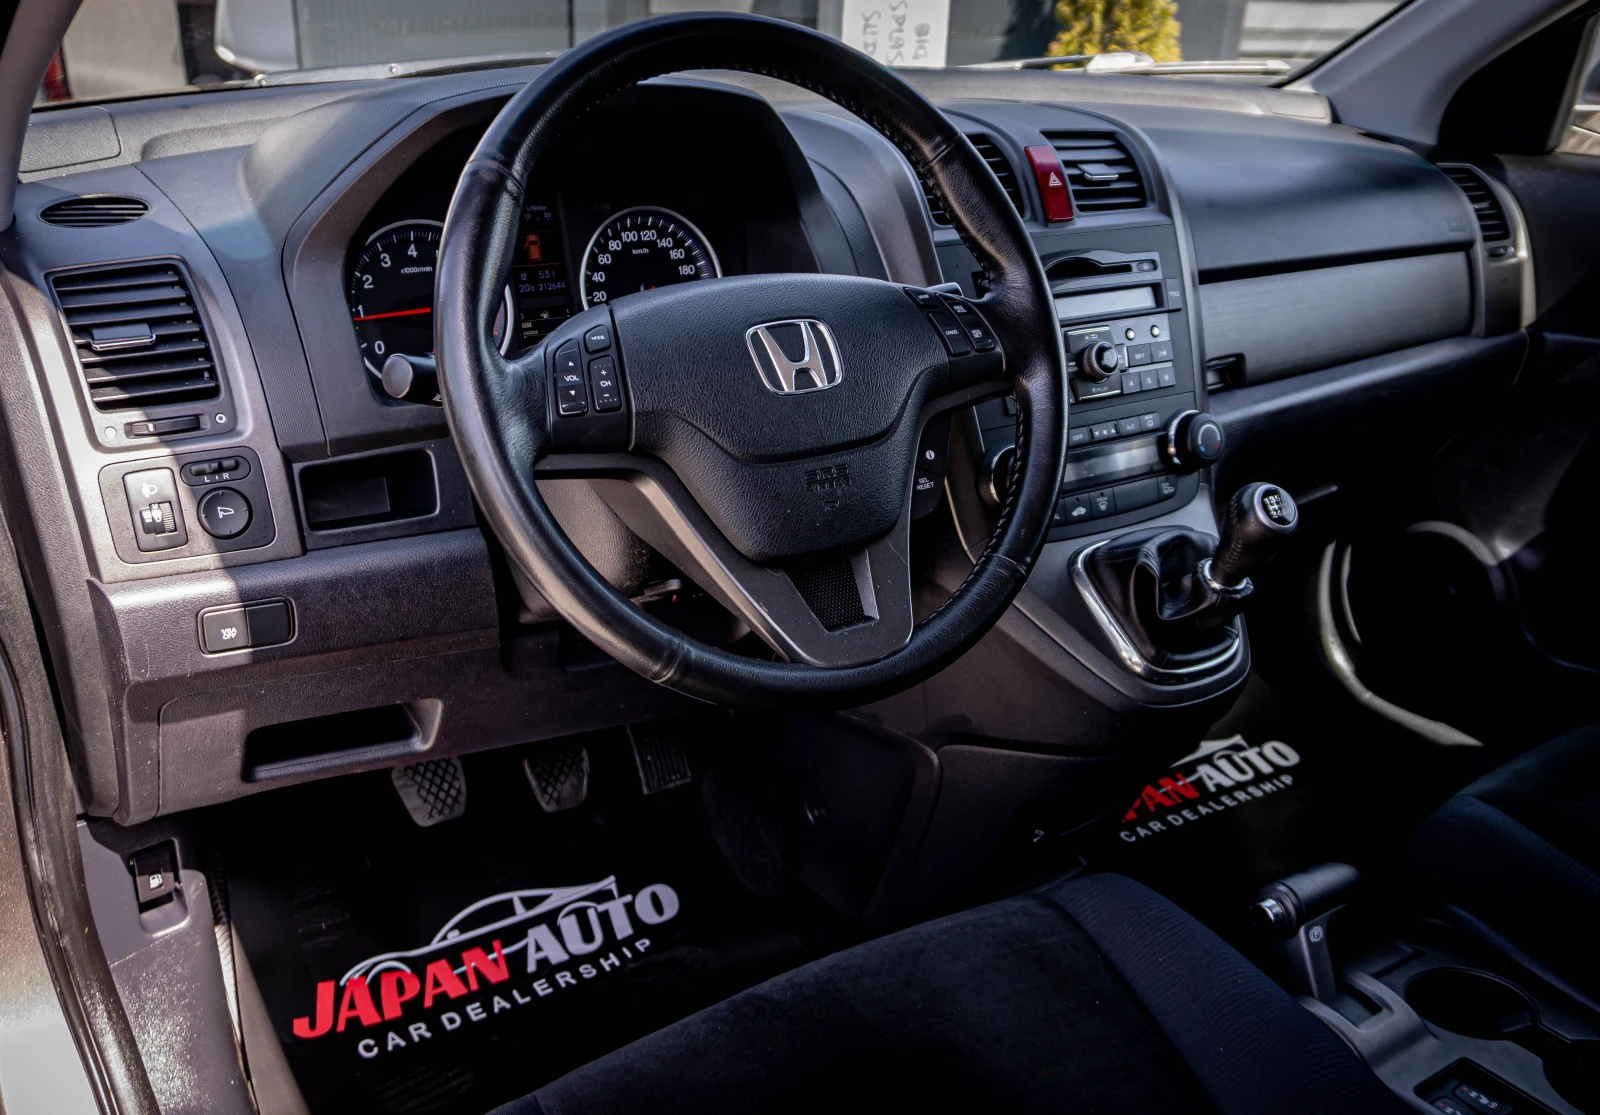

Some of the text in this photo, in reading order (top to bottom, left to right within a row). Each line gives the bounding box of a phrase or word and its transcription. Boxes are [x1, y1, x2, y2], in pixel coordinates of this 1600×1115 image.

[621, 231, 638, 242] 100
[640, 229, 657, 240] 120
[608, 240, 622, 251] 80
[656, 238, 673, 248] 140
[407, 244, 418, 258] 4
[669, 248, 685, 259] 160
[380, 253, 391, 267] 3
[598, 253, 612, 264] 60
[678, 265, 695, 275] 180
[362, 275, 374, 289] 2
[592, 271, 605, 282] 40
[593, 291, 607, 302] 20
[374, 341, 385, 354] 0
[1072, 433, 1084, 441] OFF
[223, 472, 229, 480] R
[1196, 740, 1302, 793] AUTO
[1119, 774, 1294, 843] CAR DEALERSHIP
[293, 883, 680, 1039] JAPAN AUTO
[357, 938, 652, 1059] CAR DEALERSHIP
